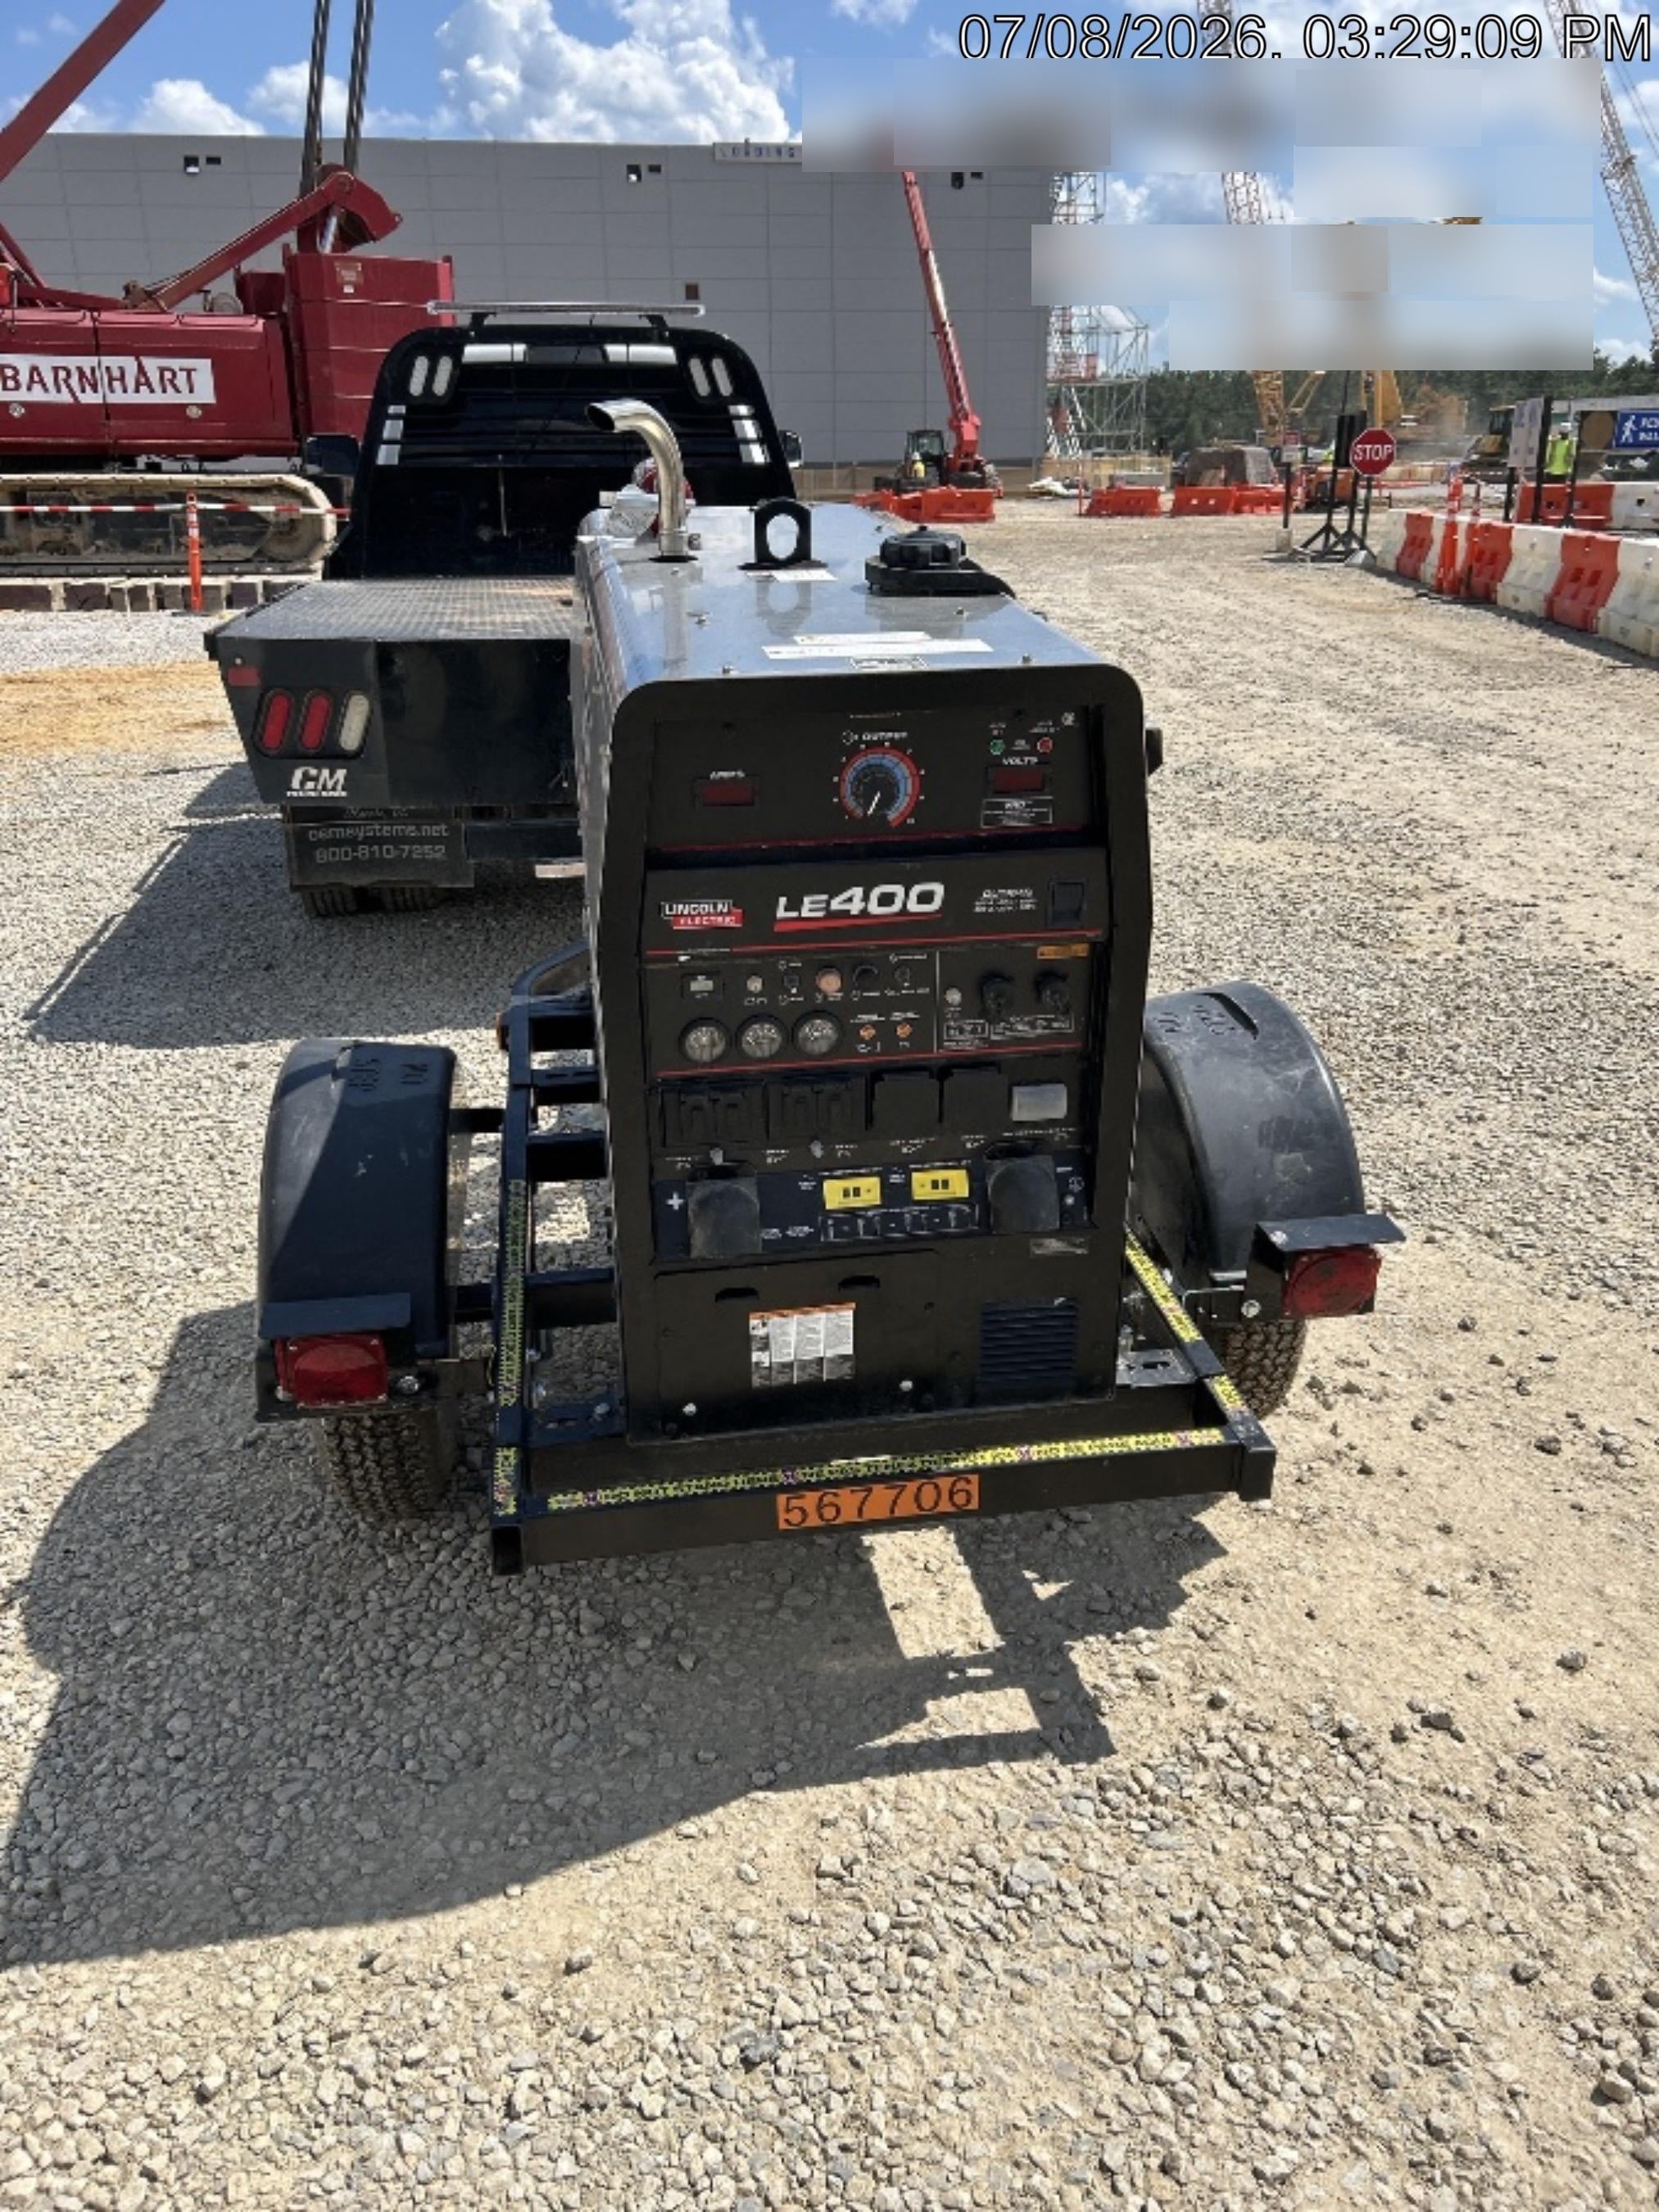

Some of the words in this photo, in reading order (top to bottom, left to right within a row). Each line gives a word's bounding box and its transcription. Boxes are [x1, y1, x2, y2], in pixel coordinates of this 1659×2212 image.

[0, 357, 198, 404] BARNHART
[1353, 444, 1394, 461] STOP
[664, 901, 730, 917] LINCOLN
[775, 882, 945, 921] LE400
[679, 915, 737, 926] ELECTRIC
[782, 1476, 974, 1528] 567706
